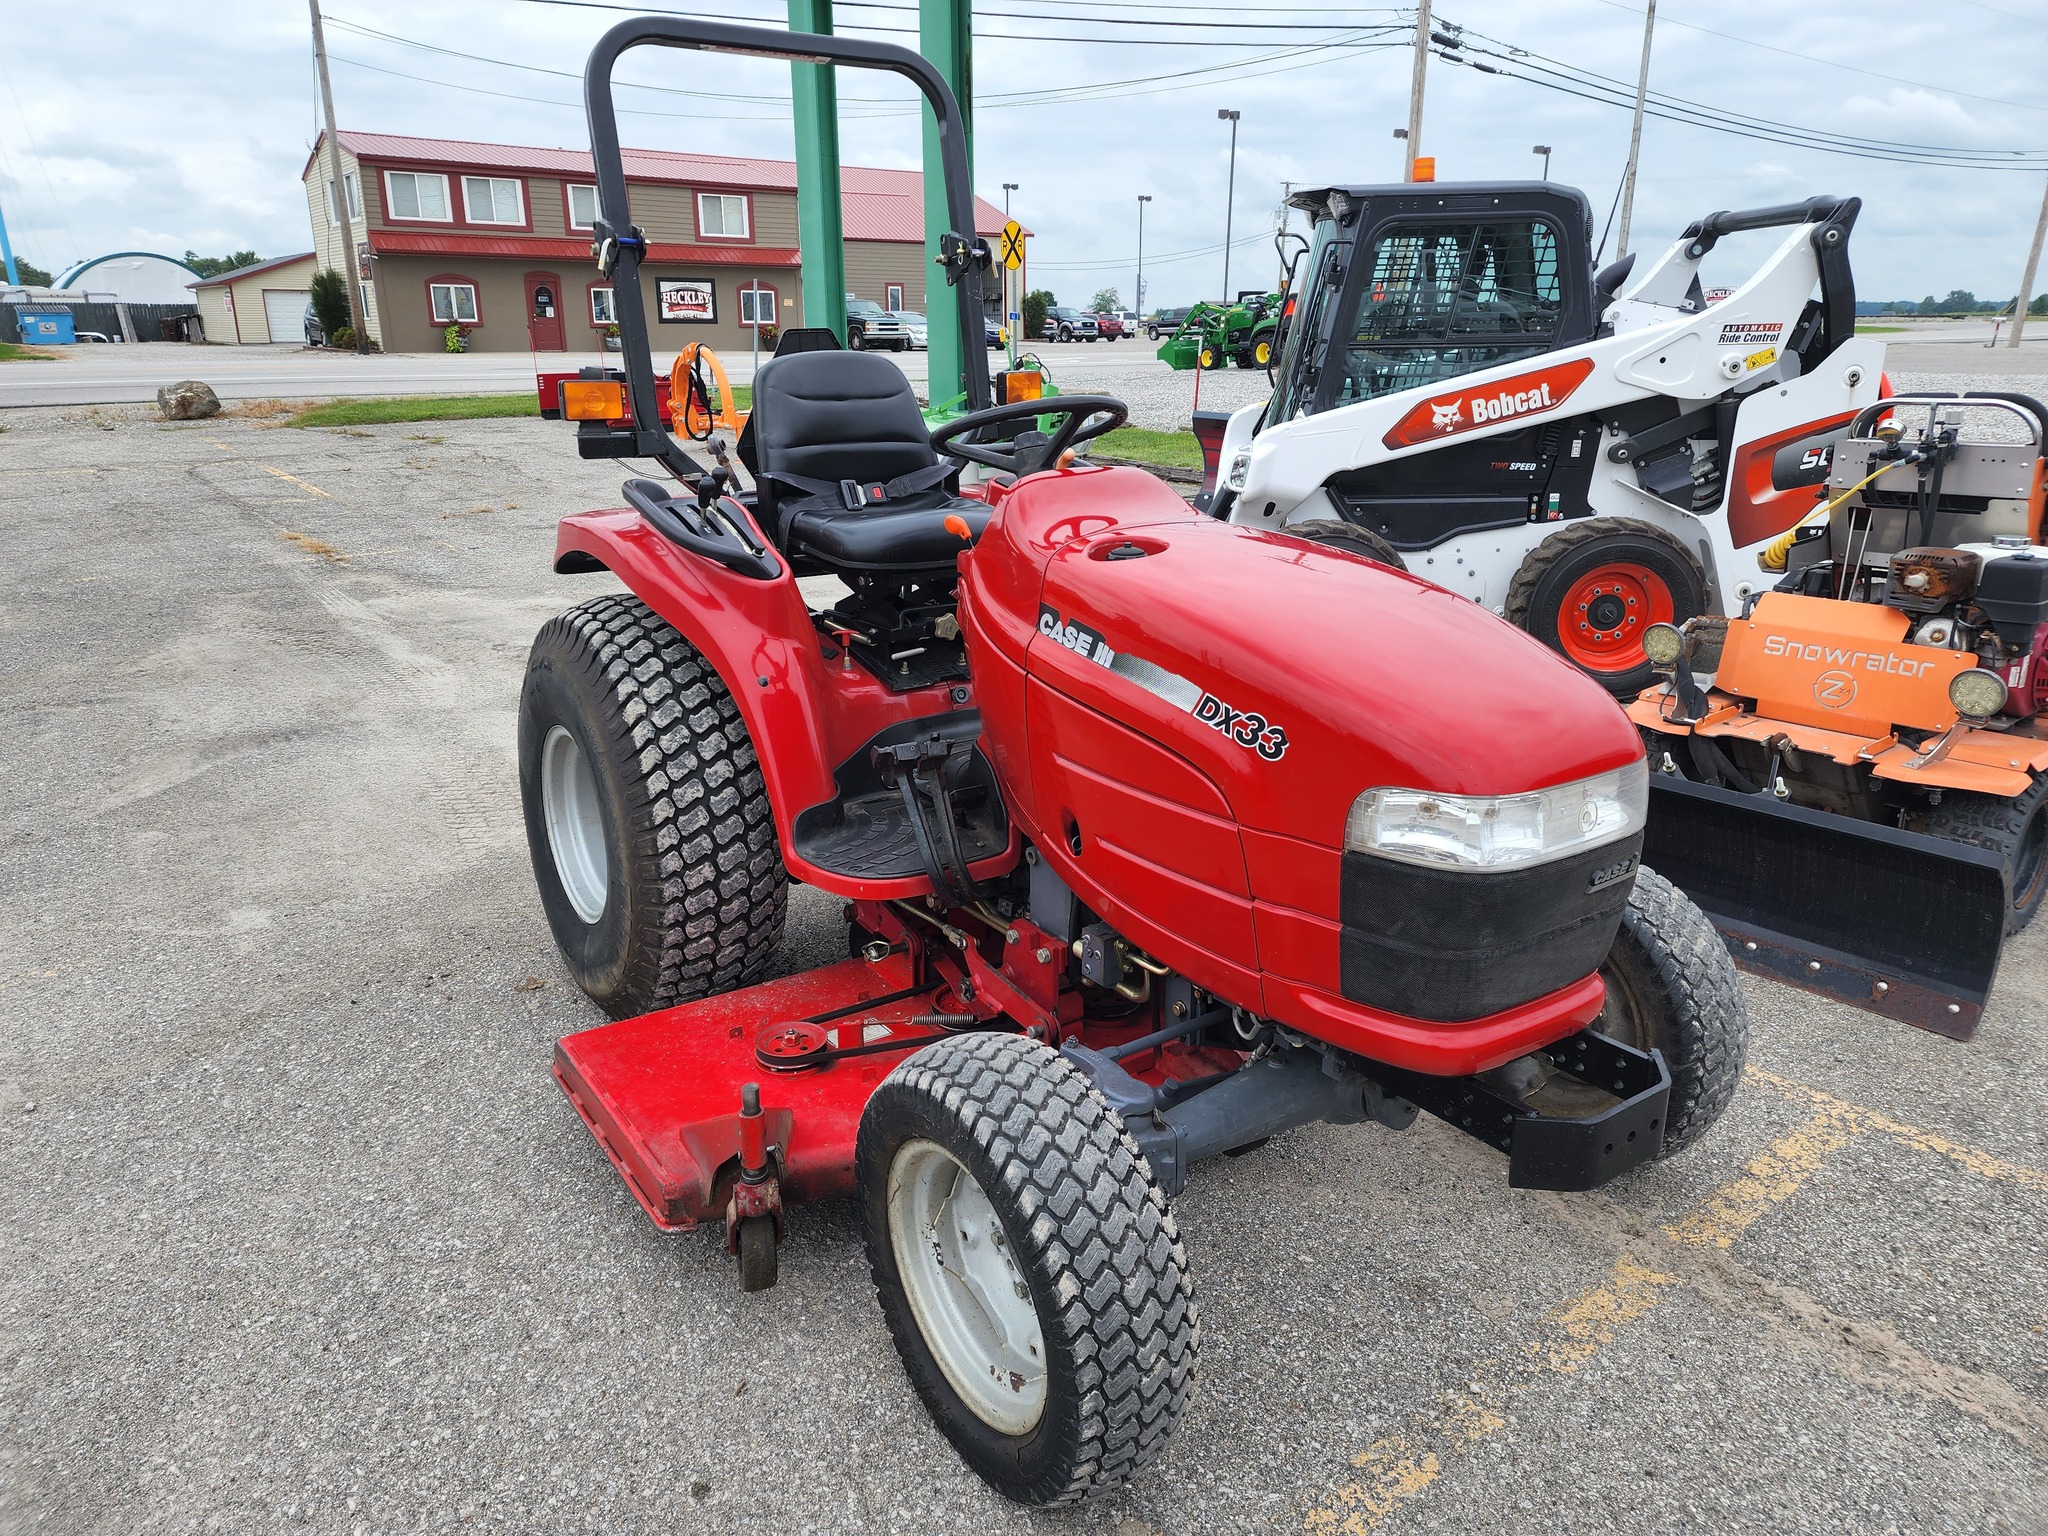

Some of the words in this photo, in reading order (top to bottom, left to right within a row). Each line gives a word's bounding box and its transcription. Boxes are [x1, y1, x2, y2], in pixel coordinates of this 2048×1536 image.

[1003, 241, 1007, 252] R
[1018, 240, 1022, 251] R
[662, 291, 711, 304] HECKLEY
[1718, 333, 1741, 343] Ride
[1743, 332, 1780, 343] Control
[1724, 324, 1781, 332] AUTOMATIC
[1471, 383, 1551, 424] Bobcat
[1509, 462, 1537, 471] SPEED
[1039, 612, 1093, 657] CASE
[1763, 634, 1936, 678] Snowrator
[1193, 692, 1290, 762] DX33
[1591, 859, 1630, 885] CASE
